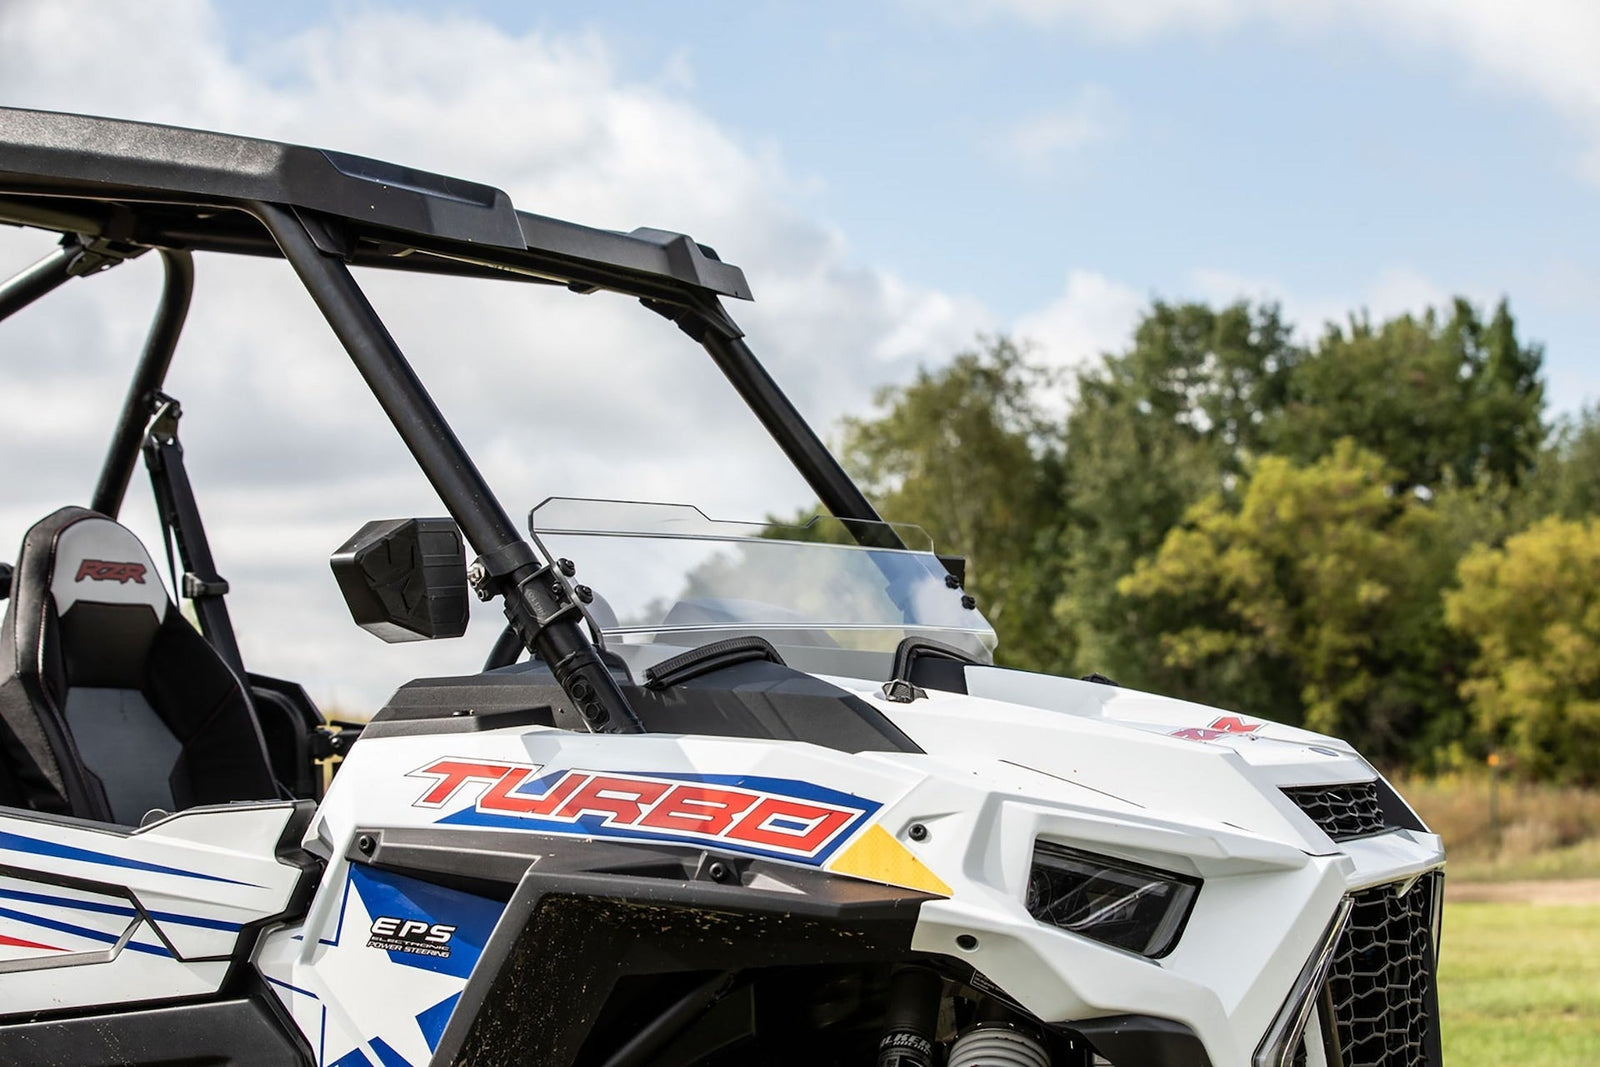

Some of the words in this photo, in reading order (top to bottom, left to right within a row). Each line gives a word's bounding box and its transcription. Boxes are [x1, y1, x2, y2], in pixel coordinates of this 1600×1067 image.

[75, 559, 147, 584] RZR
[412, 758, 862, 856] TURBO
[371, 916, 456, 943] EPS
[367, 941, 402, 951] POWER
[403, 946, 450, 958] STEERING
[371, 936, 450, 951] ELECTRONIC
